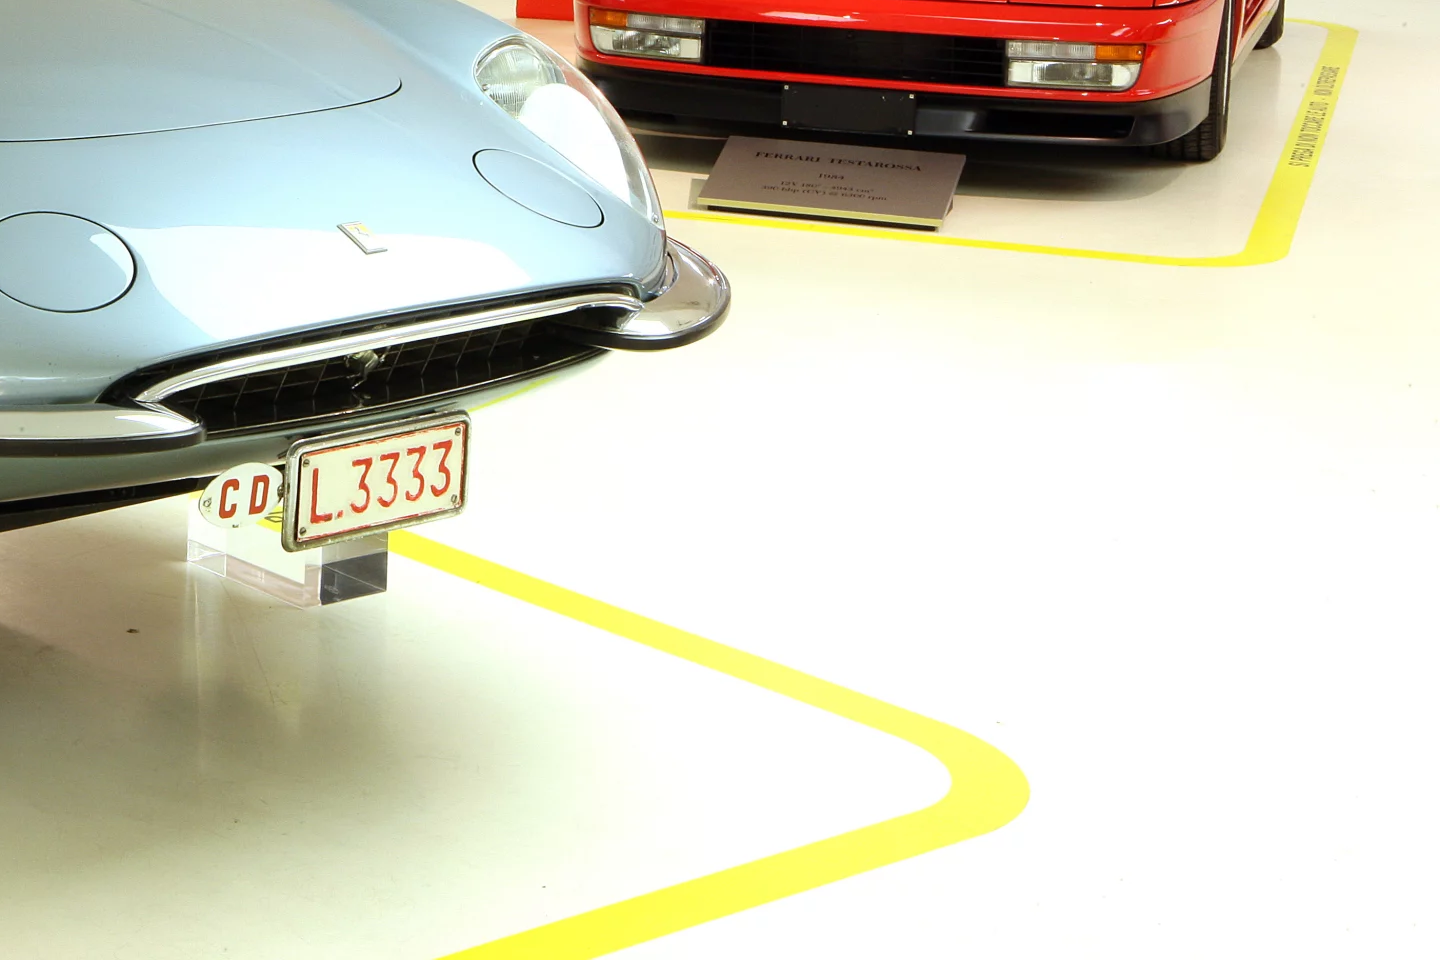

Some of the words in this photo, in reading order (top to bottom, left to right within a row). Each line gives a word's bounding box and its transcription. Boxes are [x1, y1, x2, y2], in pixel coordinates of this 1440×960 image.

[755, 151, 821, 163] FERRARI
[829, 158, 922, 172] TESTAROSSA
[219, 474, 270, 519] CD
[310, 439, 453, 524] L.3333
